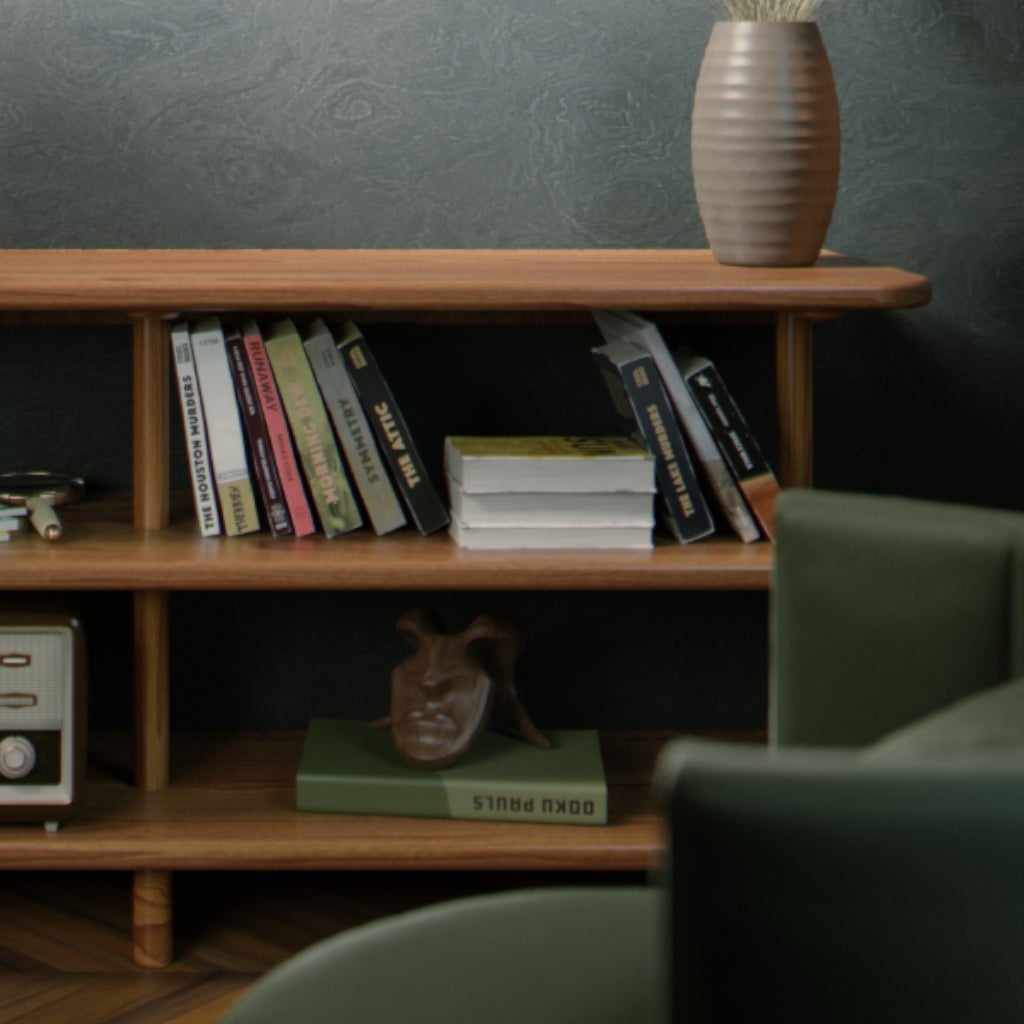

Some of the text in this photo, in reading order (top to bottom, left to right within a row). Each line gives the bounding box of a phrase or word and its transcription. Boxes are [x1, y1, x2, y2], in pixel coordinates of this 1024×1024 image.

[250, 340, 278, 412] RUNAWAY
[182, 374, 216, 531] THE HOUSTON MURDERS
[303, 422, 340, 505] MORNING
[338, 398, 381, 485] SYMMETRY
[374, 402, 422, 489] THE ATTIC
[646, 404, 696, 518] THE LAKE MURDERS
[472, 795, 595, 815] DOKU PAULS
